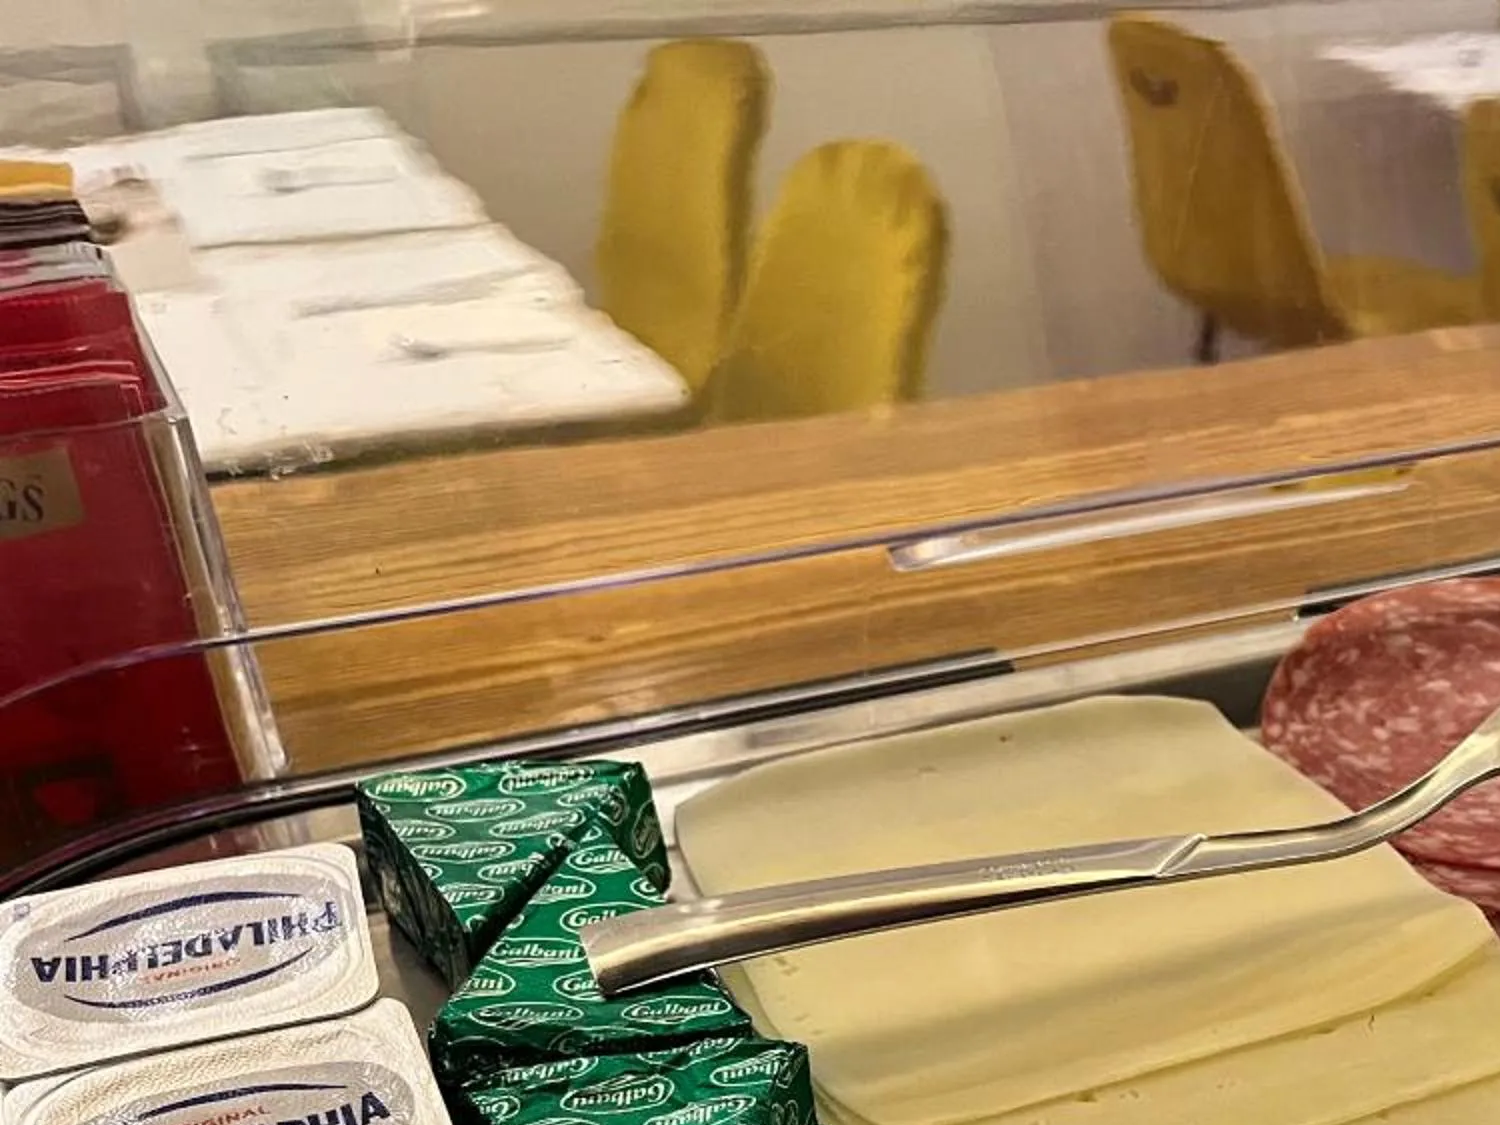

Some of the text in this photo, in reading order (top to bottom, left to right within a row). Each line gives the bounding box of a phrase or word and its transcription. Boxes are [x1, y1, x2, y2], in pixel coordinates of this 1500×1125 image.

[376, 779, 458, 797] Galbani
[435, 801, 517, 816] Galbani
[421, 846, 509, 859] Galbani
[30, 902, 344, 983] PHILADELPHIA
[492, 943, 580, 959] Galbani
[631, 1001, 721, 1017] Galbani
[573, 1083, 665, 1107] Galbani
